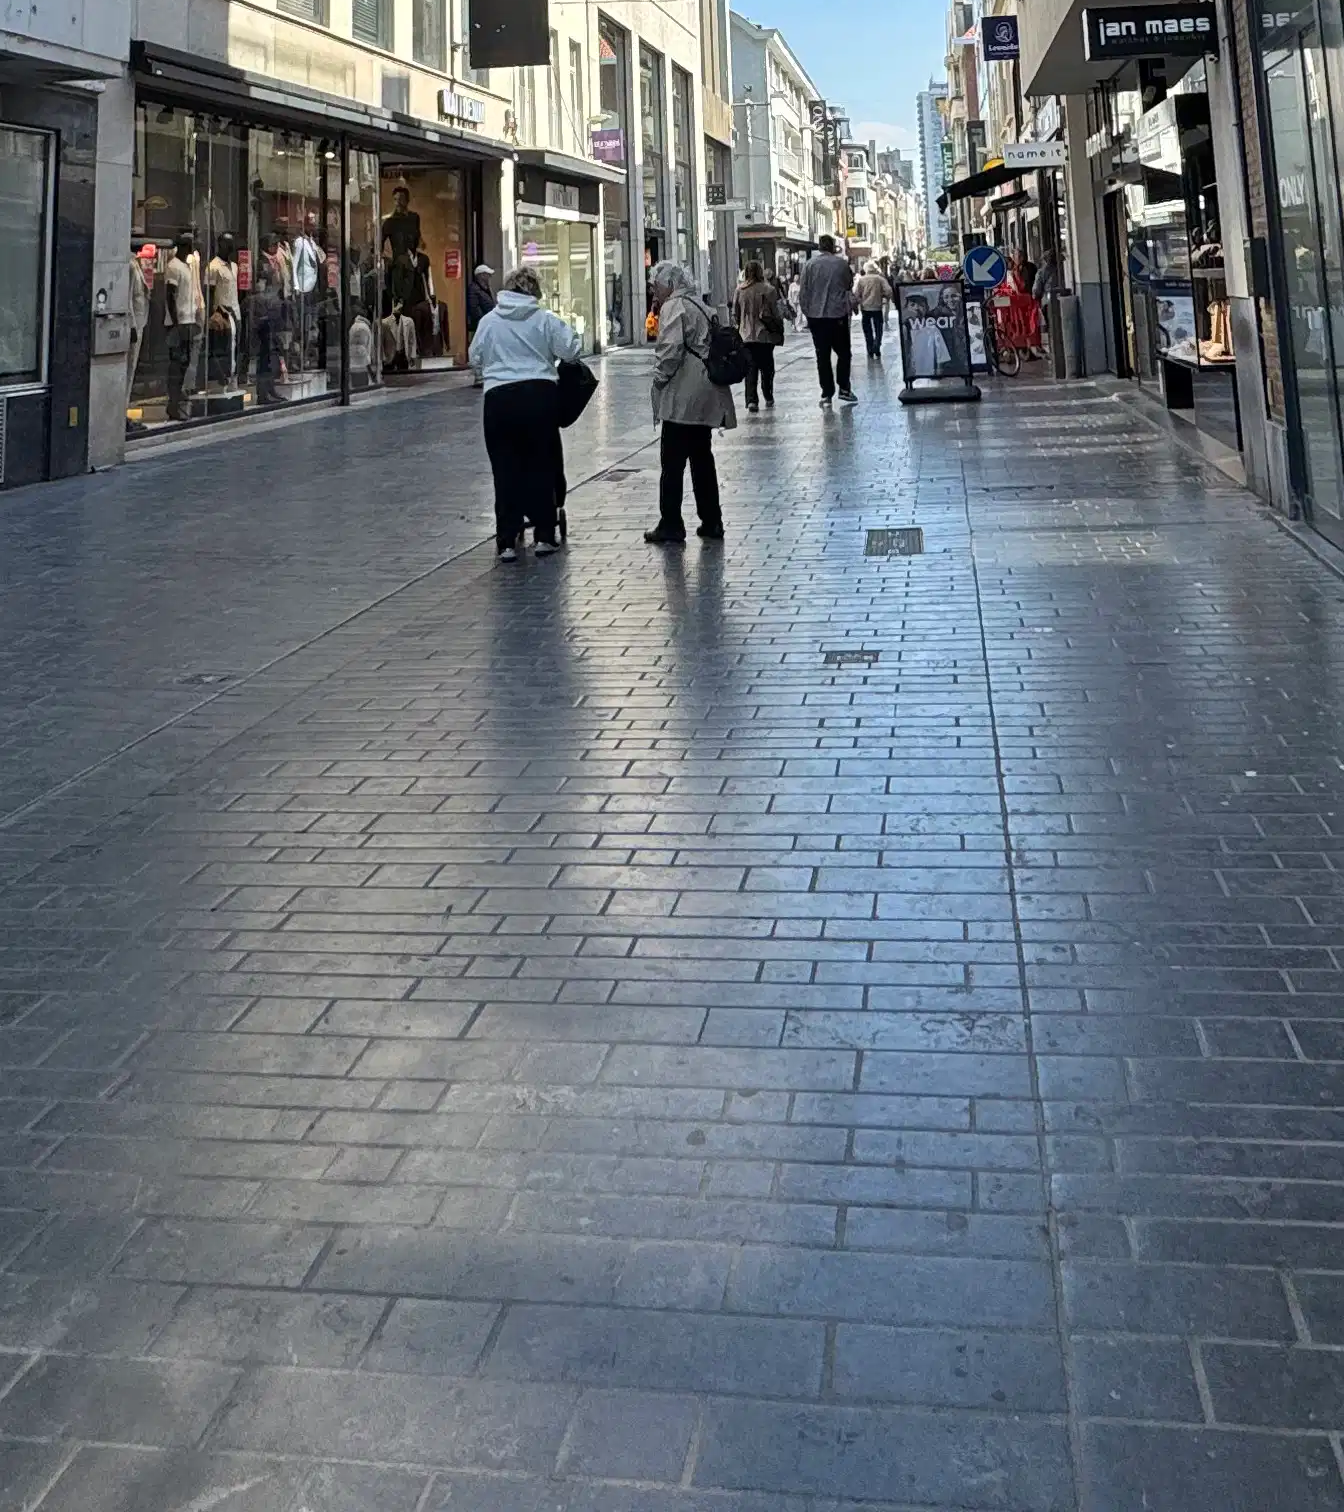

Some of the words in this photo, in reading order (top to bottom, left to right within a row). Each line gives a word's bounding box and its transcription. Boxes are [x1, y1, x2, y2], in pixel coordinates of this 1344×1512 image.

[1098, 19, 1136, 45] jan
[1145, 17, 1210, 34] maes
[1007, 149, 1047, 159] name
[1050, 148, 1062, 157] it
[1280, 173, 1305, 208] ONLY
[908, 315, 957, 330] wear
